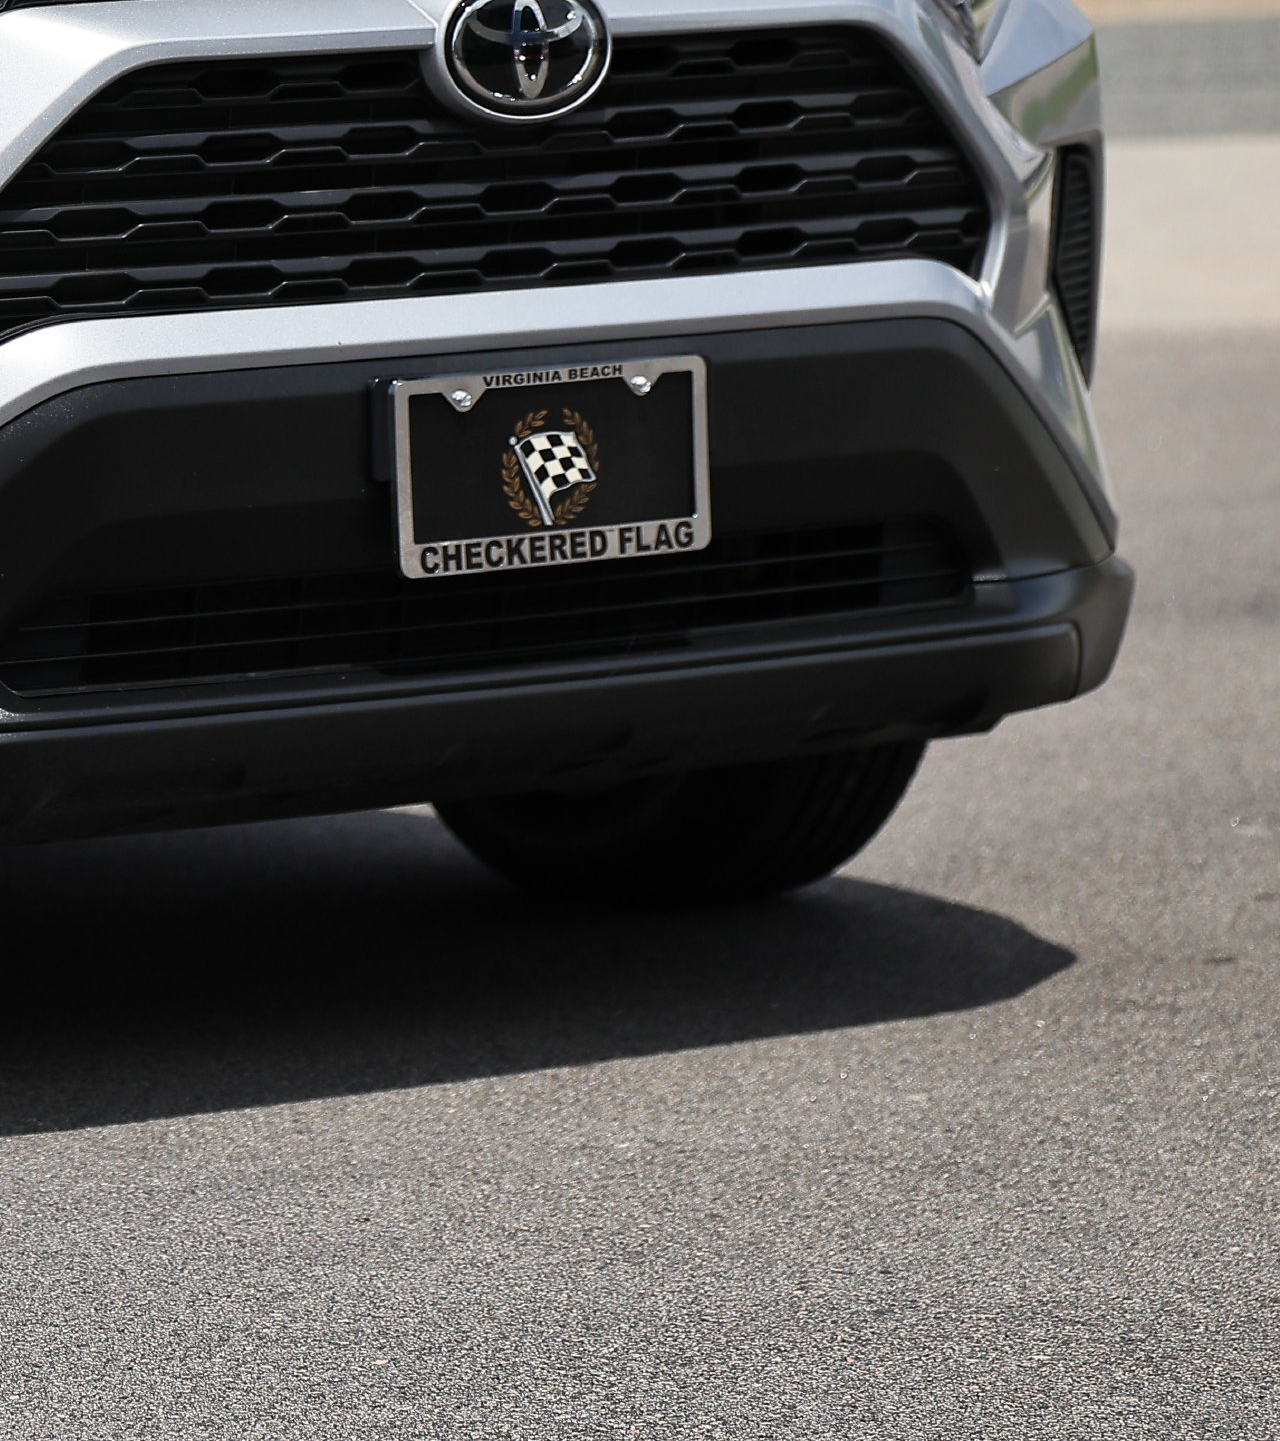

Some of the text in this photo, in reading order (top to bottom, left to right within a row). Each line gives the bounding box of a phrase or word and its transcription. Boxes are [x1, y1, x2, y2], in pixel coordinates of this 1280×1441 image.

[482, 364, 623, 388] VIRGINIA BEACH
[420, 520, 695, 575] CHECKERED FLAG
